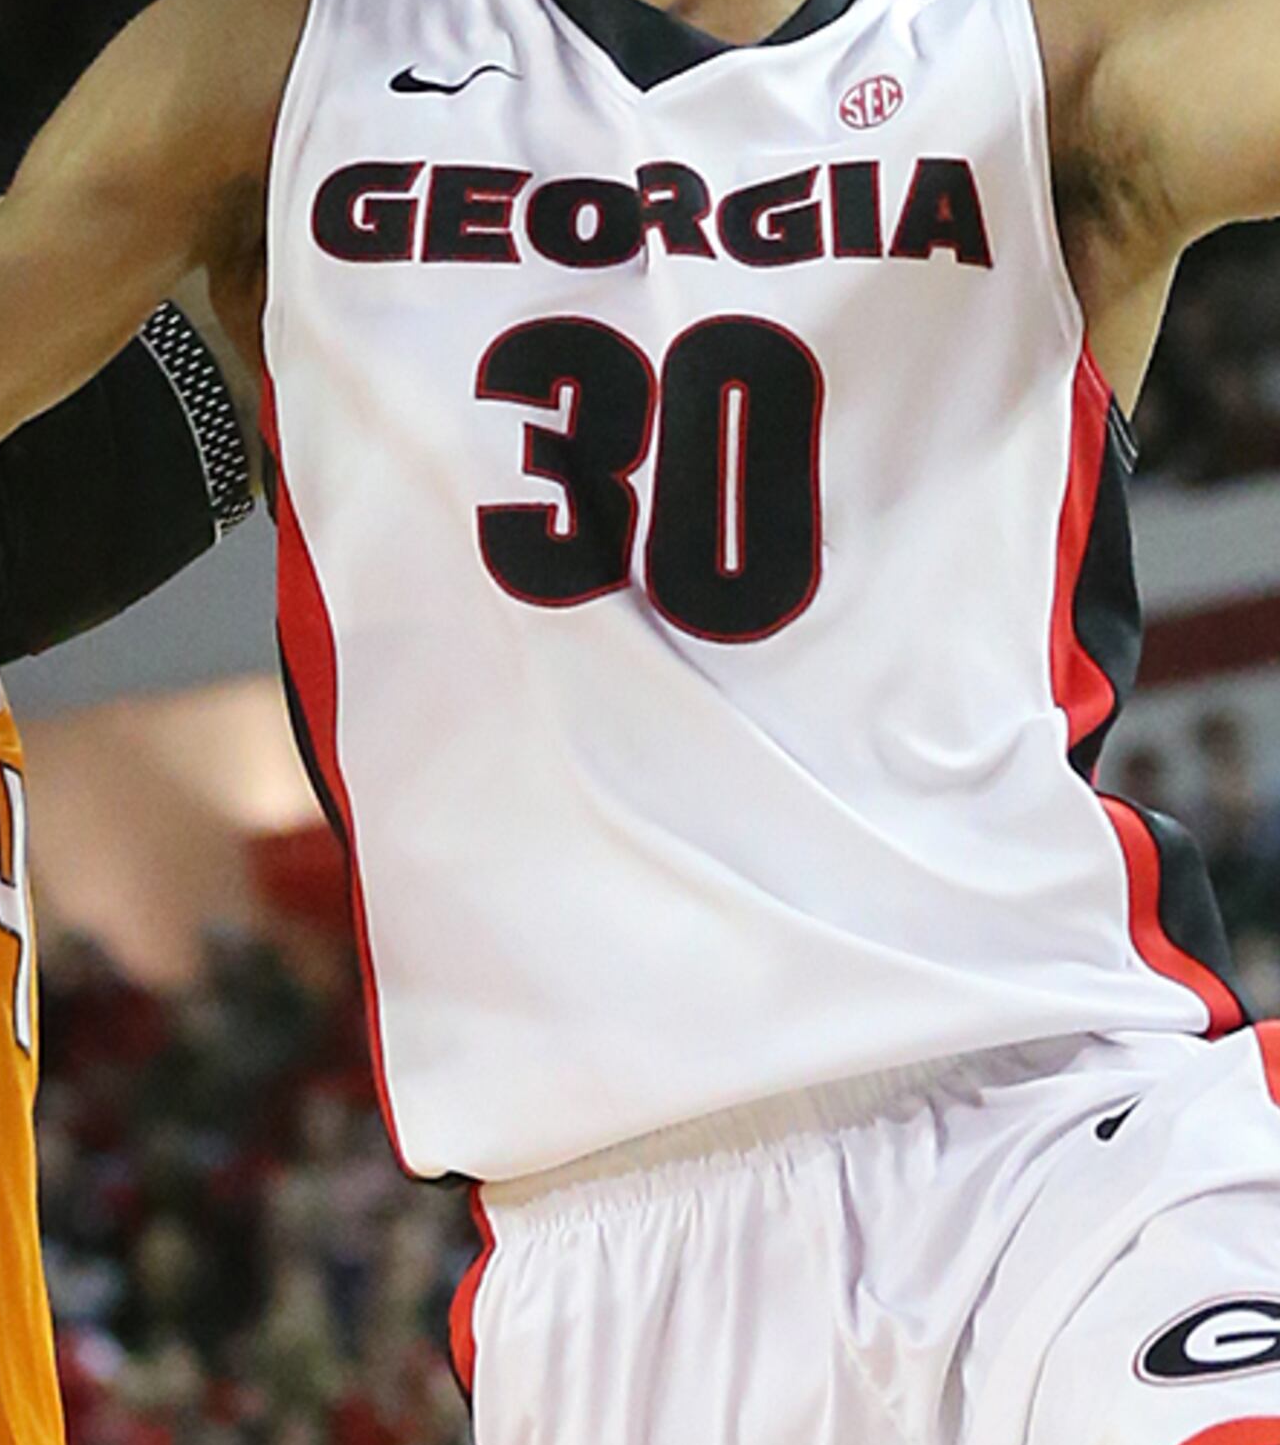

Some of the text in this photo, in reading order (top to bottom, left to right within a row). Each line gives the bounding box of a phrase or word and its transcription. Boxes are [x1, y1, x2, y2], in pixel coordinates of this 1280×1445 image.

[842, 78, 901, 126] SEC
[311, 158, 993, 270] GEORGIA
[475, 314, 825, 645] 30
